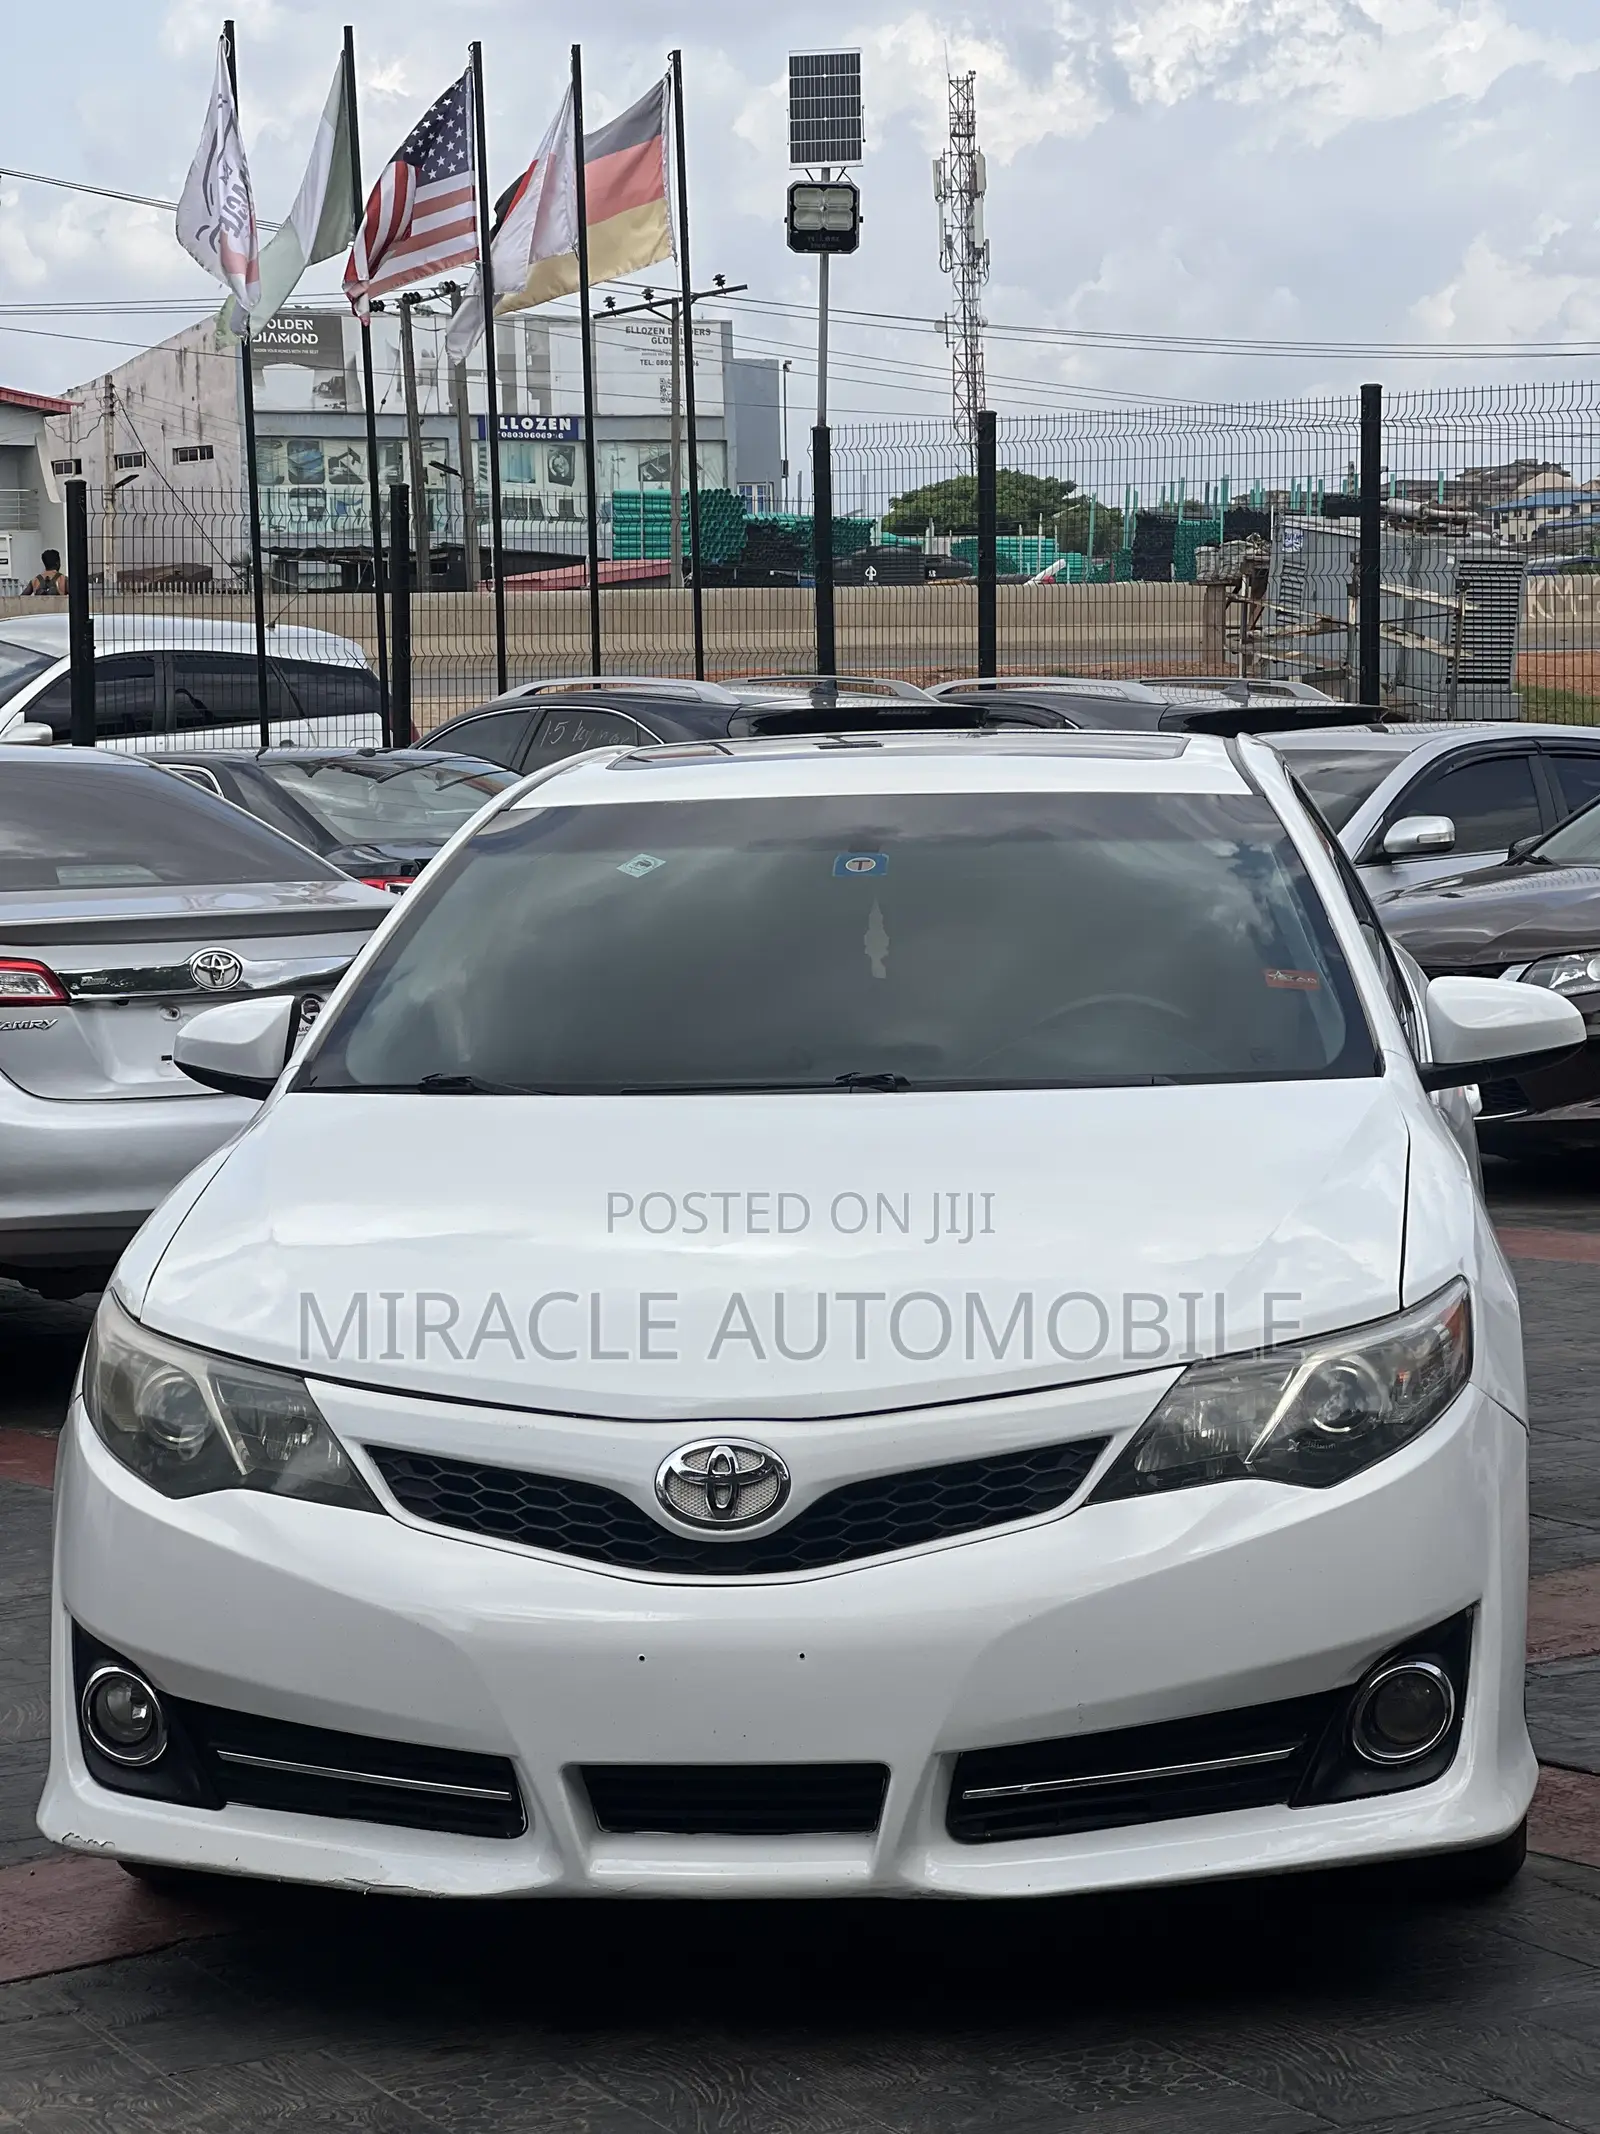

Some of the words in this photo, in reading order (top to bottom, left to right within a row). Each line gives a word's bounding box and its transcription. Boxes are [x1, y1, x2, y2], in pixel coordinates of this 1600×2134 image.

[267, 318, 314, 331] OLDEN
[625, 326, 665, 335] ELLOZEN
[499, 416, 572, 431] LLOZEN
[501, 431, 564, 439] 0803060696
[0, 1018, 59, 1031] AMRY
